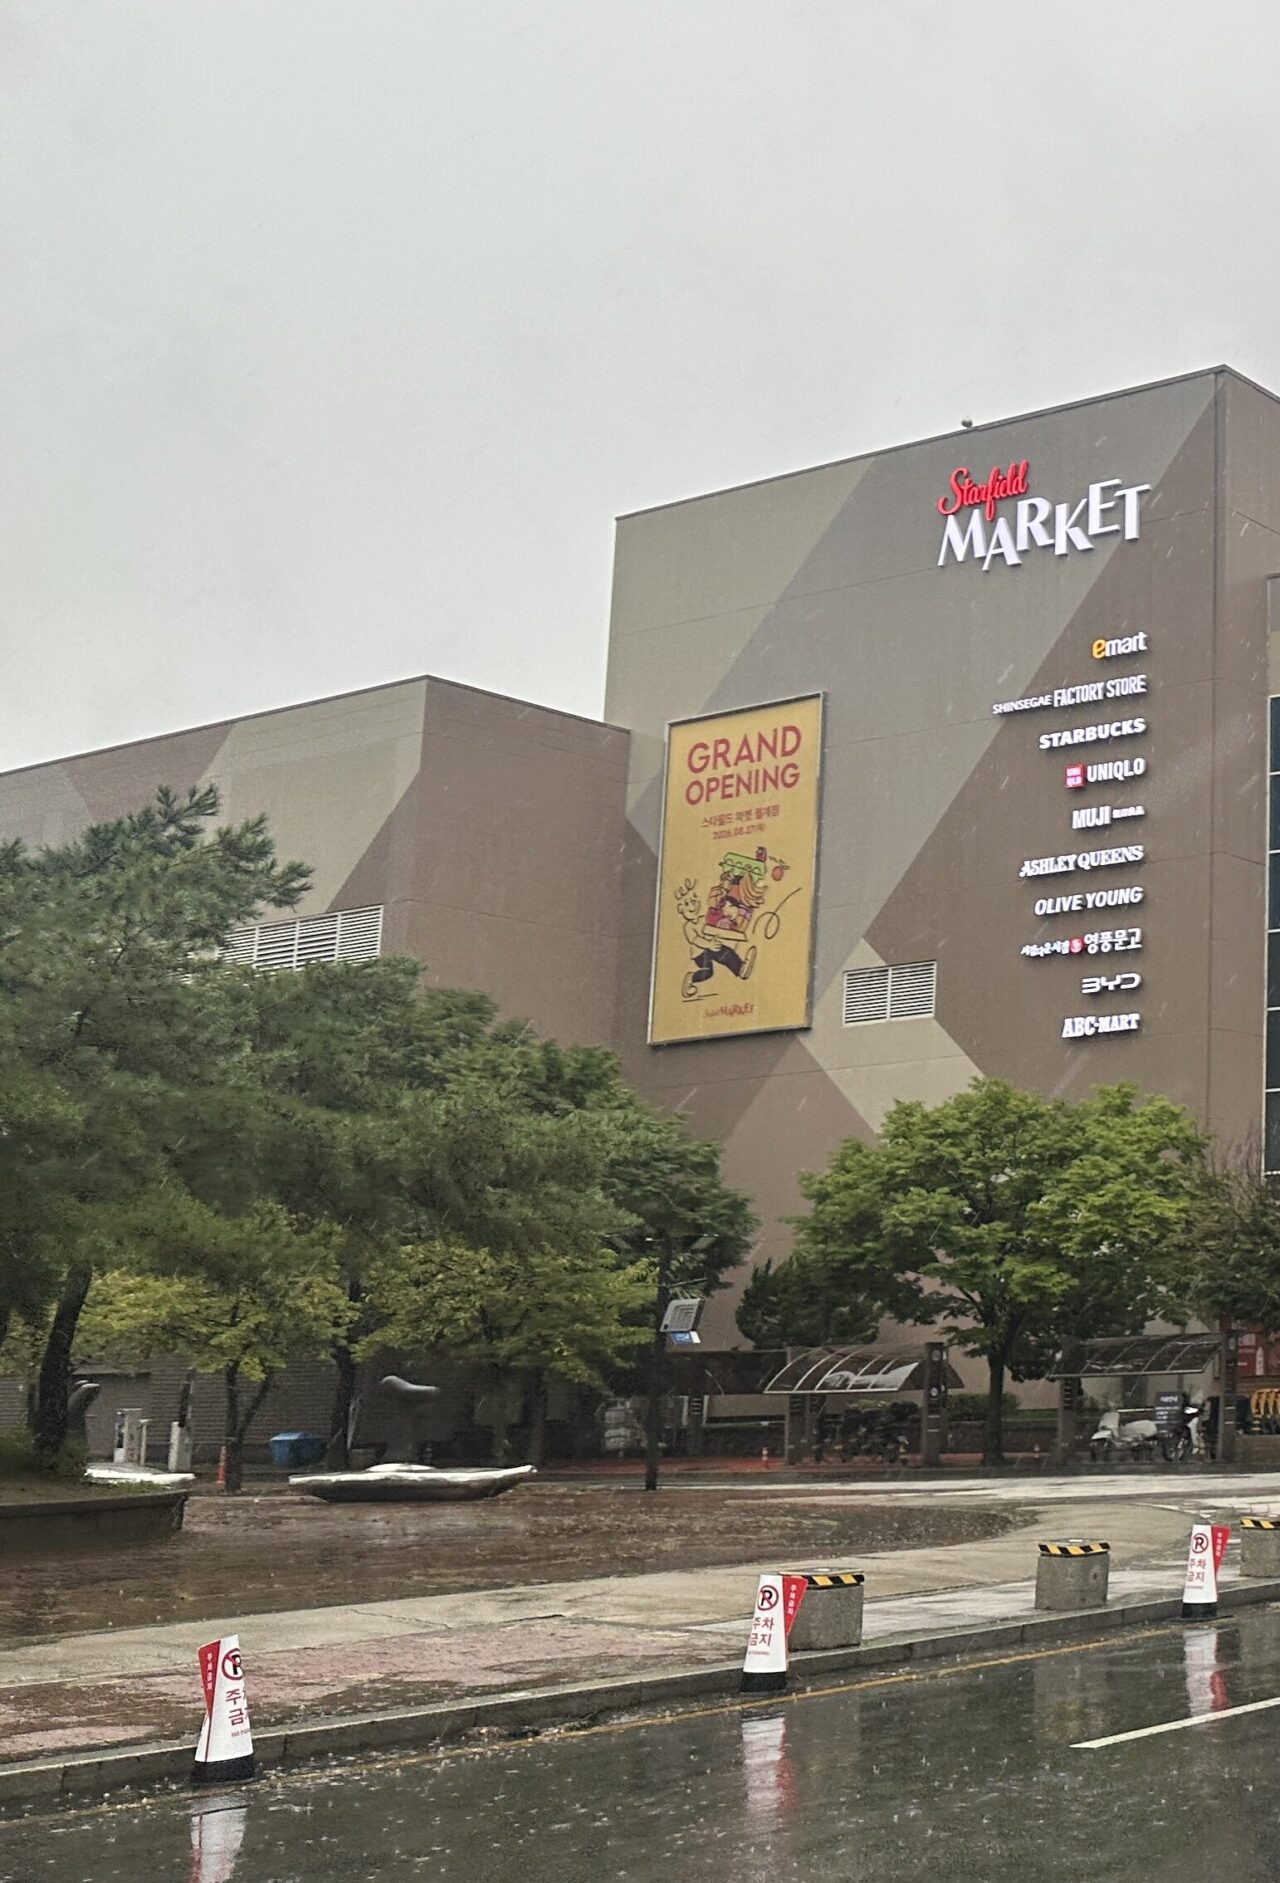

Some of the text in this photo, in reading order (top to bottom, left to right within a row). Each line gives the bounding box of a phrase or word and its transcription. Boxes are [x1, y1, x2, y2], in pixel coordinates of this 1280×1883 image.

[937, 459, 1029, 521] Starfield
[937, 478, 1151, 572] MARKET
[1092, 631, 1148, 659] emart
[992, 674, 1147, 714] SHINSEGAE FACTORY STORE
[1039, 717, 1147, 749] STARBUCKS
[687, 724, 802, 774] GRAND
[685, 762, 800, 805] OPENING
[1086, 757, 1145, 782] UNIQLO
[1072, 805, 1111, 829] MUJI
[1019, 845, 1144, 877] ASHLEY QUEENS
[1035, 887, 1144, 915] OLIVE YOUNG
[1084, 928, 1143, 954] 영풍문고
[1082, 973, 1142, 994] BYD
[750, 1632, 772, 1647] 금지
